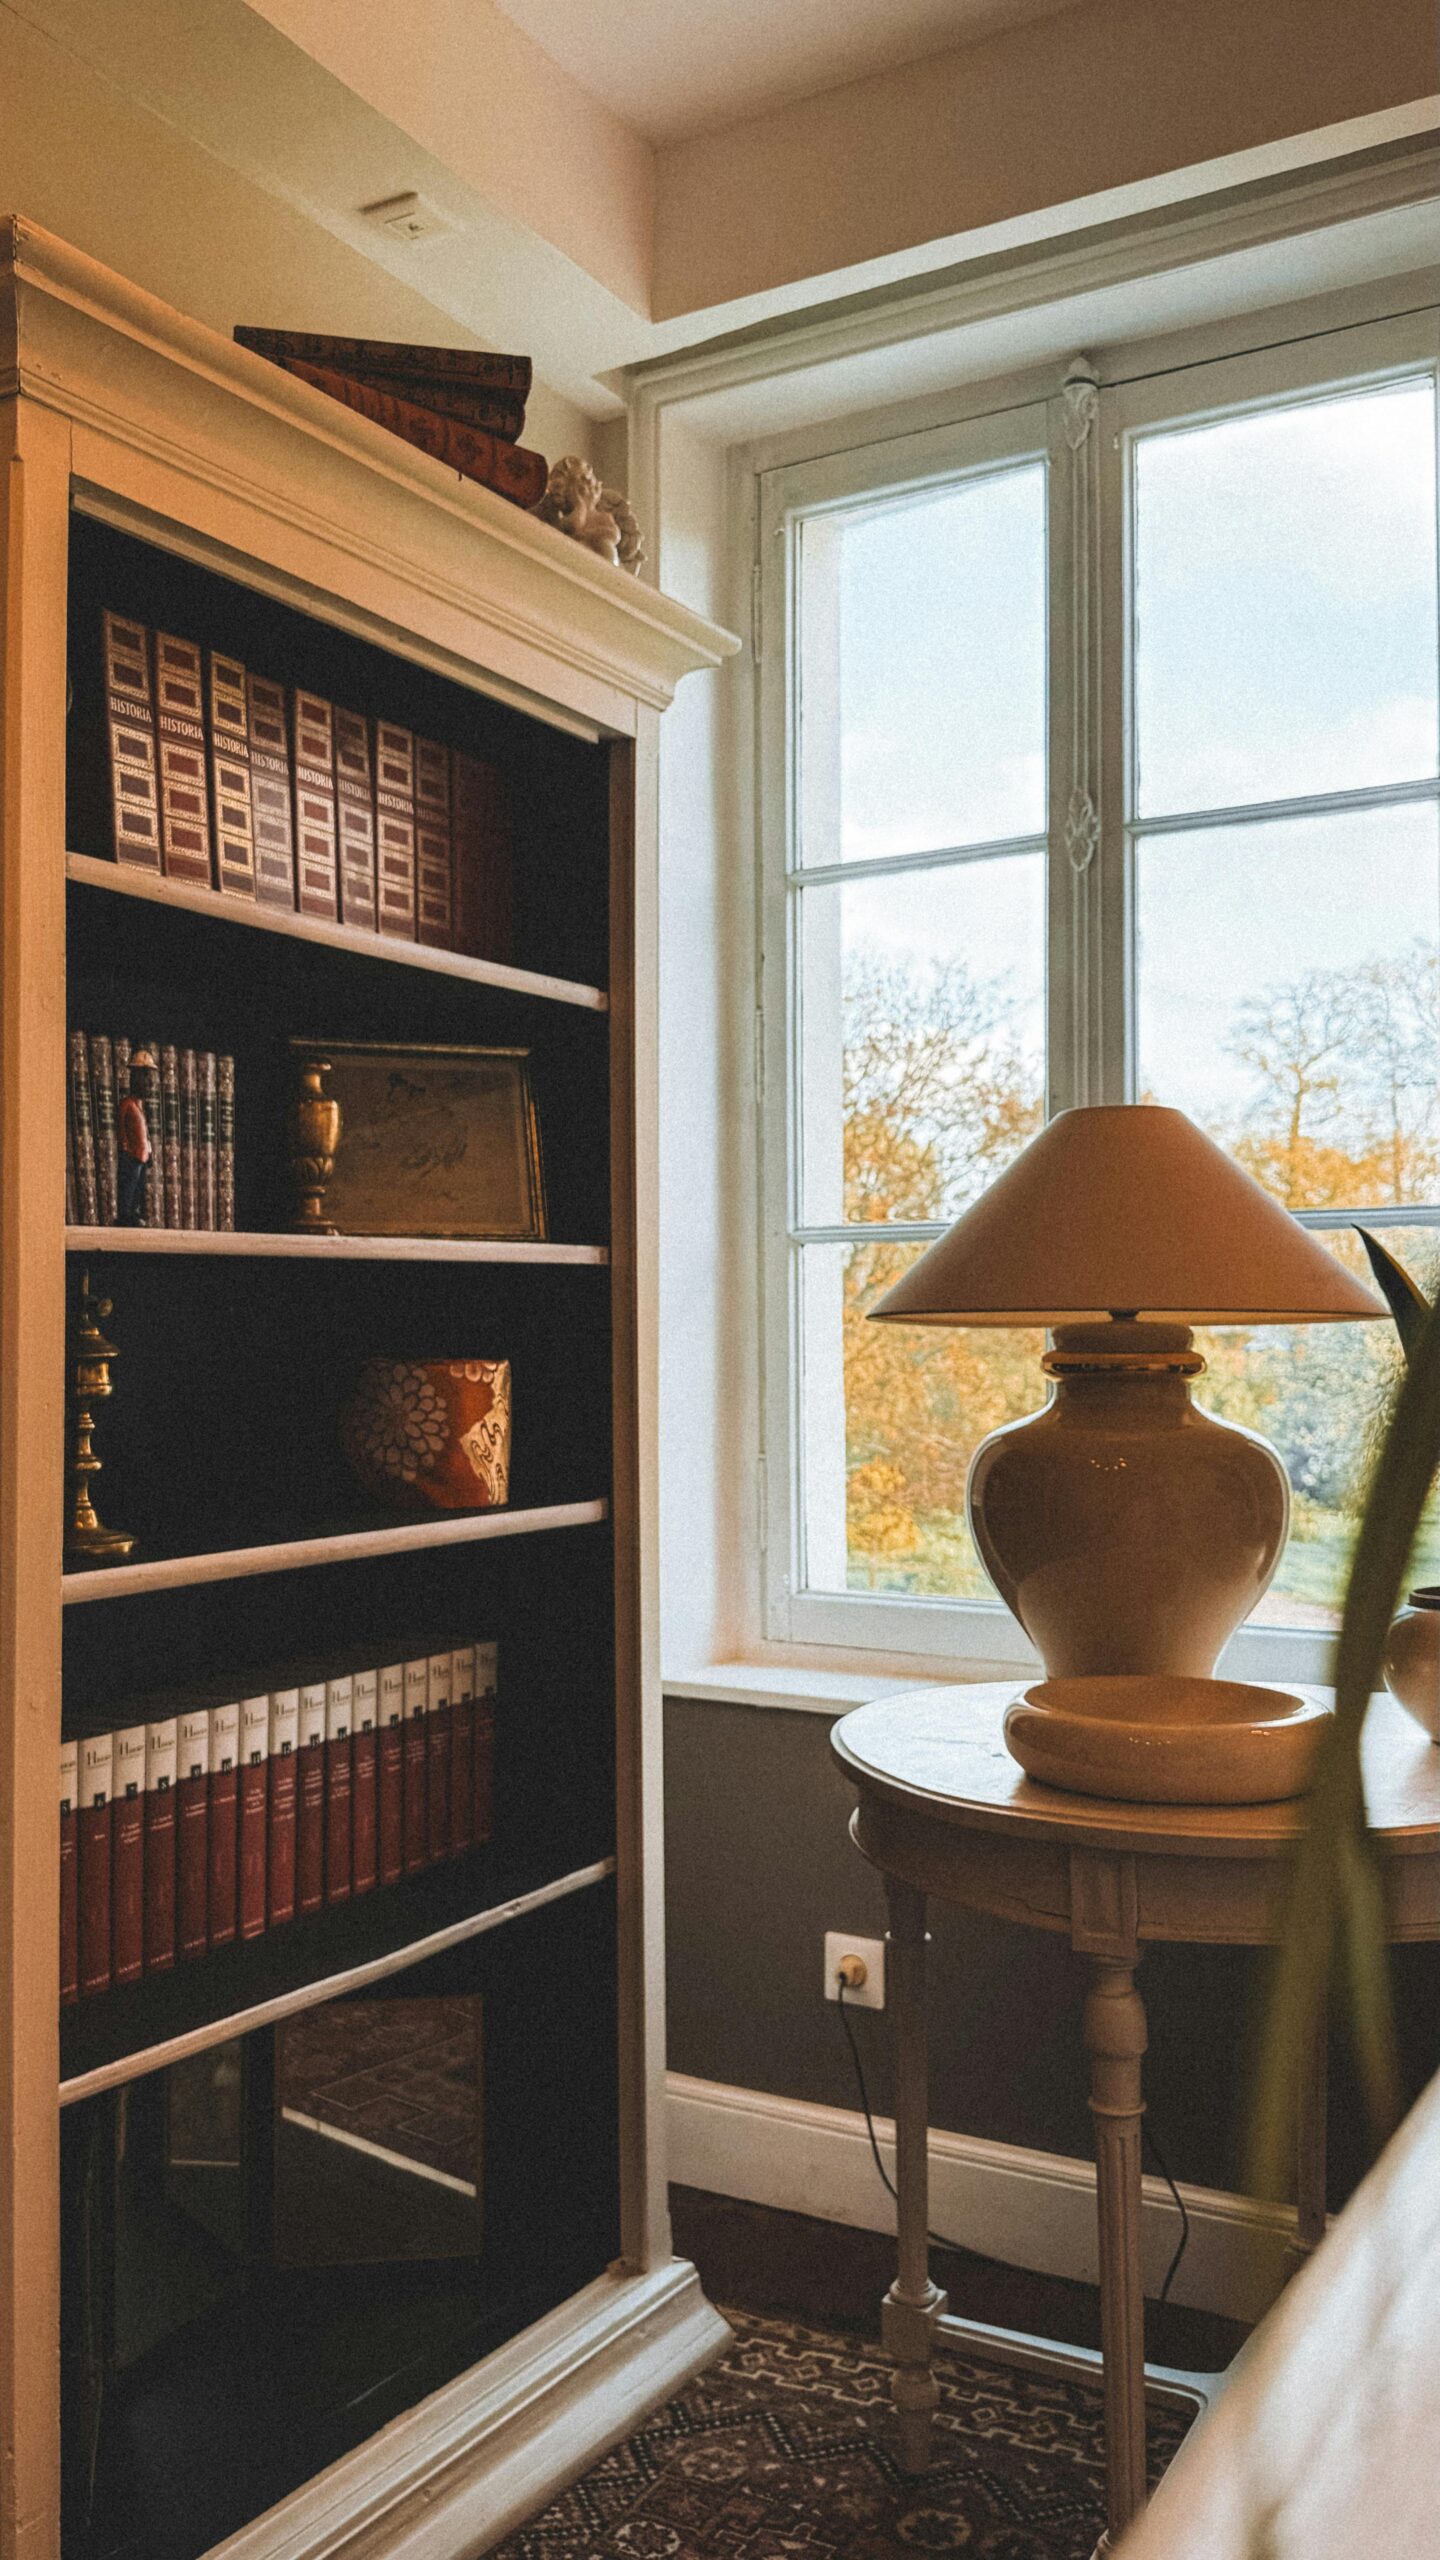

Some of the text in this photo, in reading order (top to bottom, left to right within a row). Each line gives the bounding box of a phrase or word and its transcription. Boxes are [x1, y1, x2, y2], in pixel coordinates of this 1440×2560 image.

[110, 697, 152, 723] HISTORIA
[160, 715, 204, 741] HISTORIA
[214, 732, 249, 758] HISTORIA
[252, 751, 289, 776] HISTORIA
[298, 765, 333, 790] HISTORIA
[378, 792, 414, 815] HISTORIA
